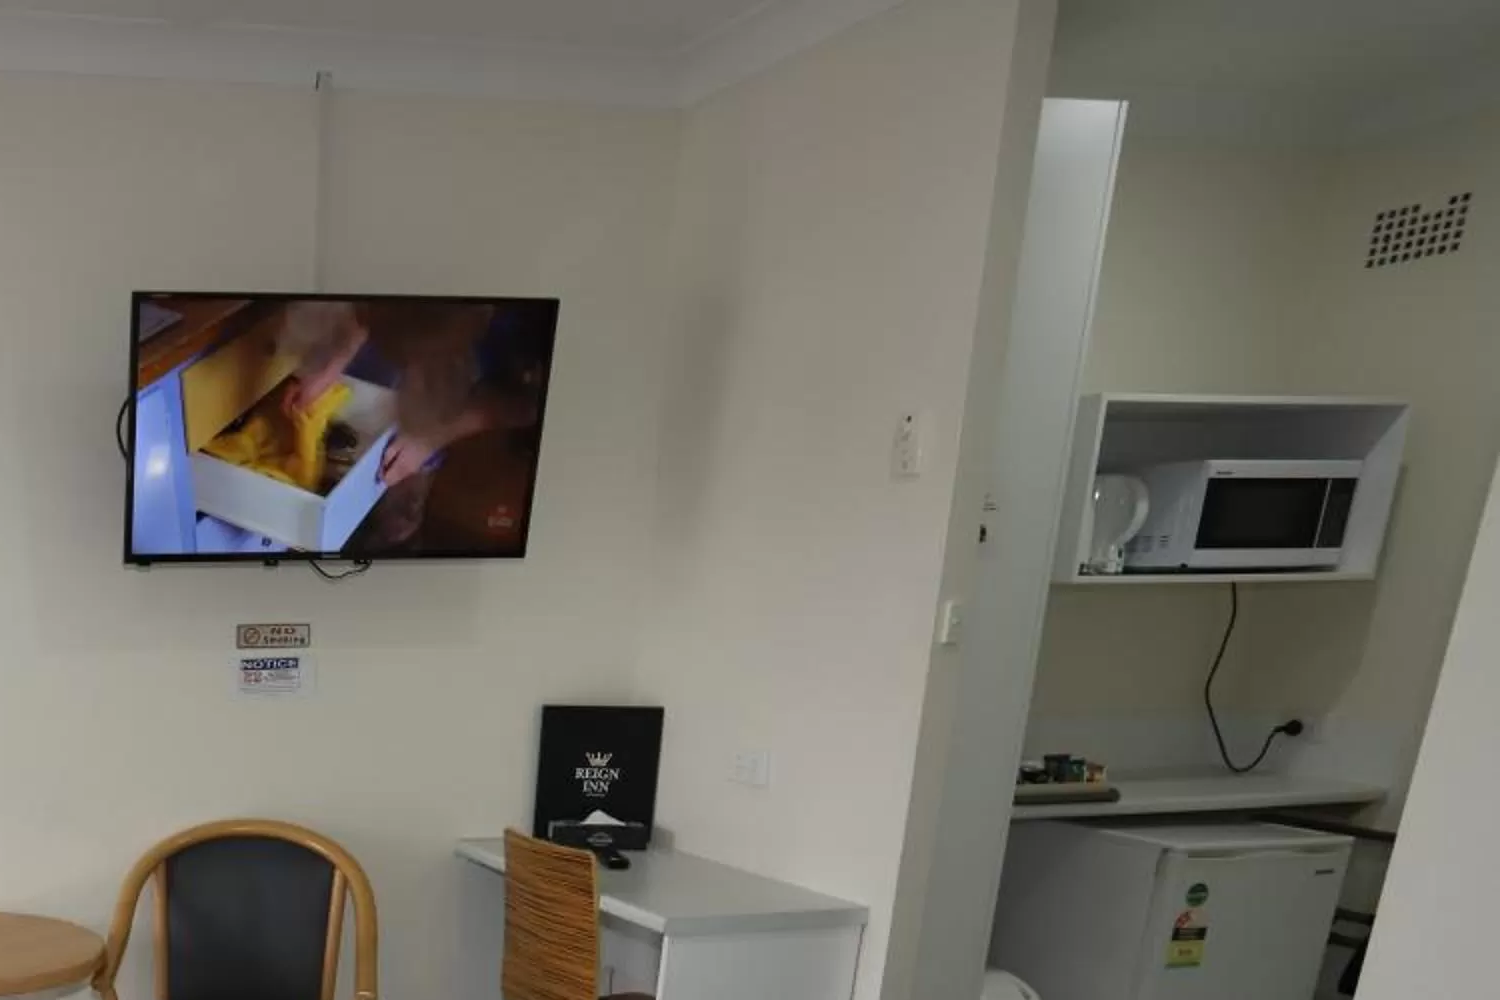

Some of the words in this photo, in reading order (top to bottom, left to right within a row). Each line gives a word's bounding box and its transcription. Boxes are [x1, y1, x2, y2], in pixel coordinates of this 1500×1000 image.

[242, 659, 297, 669] NOTICE
[575, 767, 620, 780] REIGN
[583, 780, 610, 792] INN
